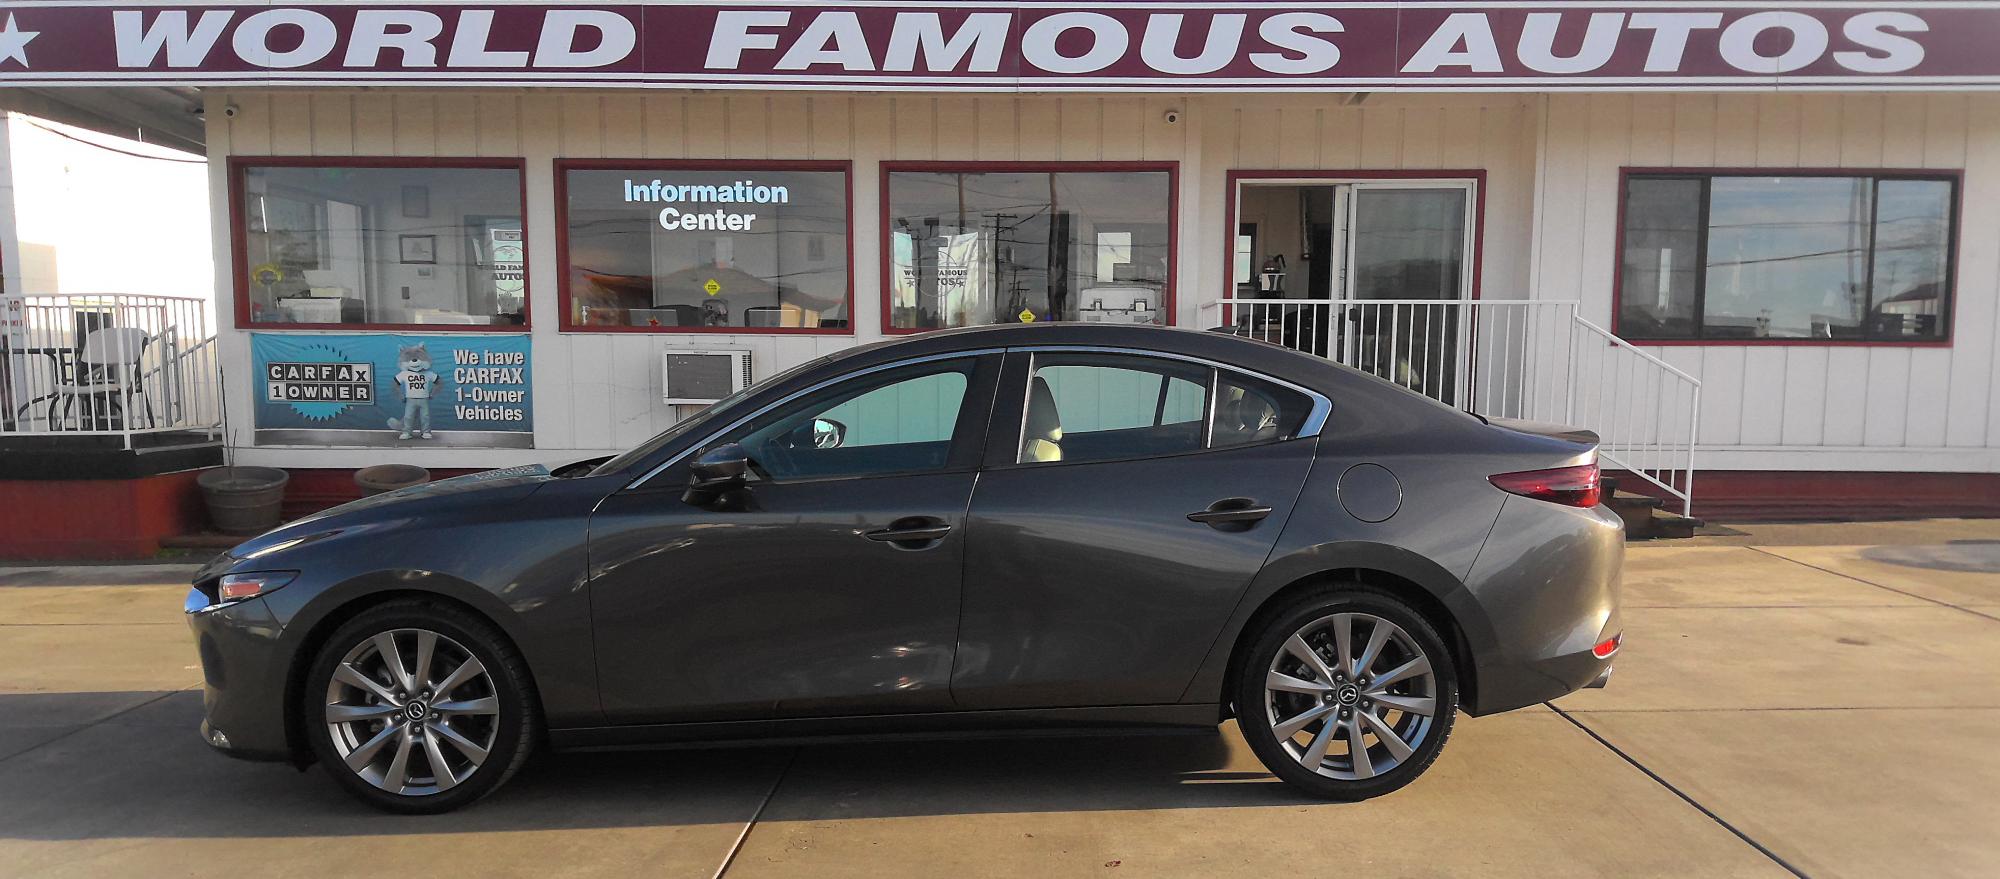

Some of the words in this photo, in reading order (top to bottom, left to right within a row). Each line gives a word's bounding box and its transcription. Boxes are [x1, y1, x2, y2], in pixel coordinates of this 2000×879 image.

[112, 9, 637, 69] WORLD
[703, 11, 1346, 74] FAMOUS
[1400, 11, 1929, 73] AUTOS
[624, 179, 789, 204] Information
[659, 207, 756, 231] Center
[453, 349, 479, 365] We
[484, 349, 524, 365] have
[270, 364, 367, 382] CARFAX
[407, 374, 426, 383] CAR
[454, 367, 523, 385] CARFAX
[409, 382, 426, 391] FOX
[454, 387, 524, 403] 1-Owner
[454, 405, 523, 421] Vehicles
